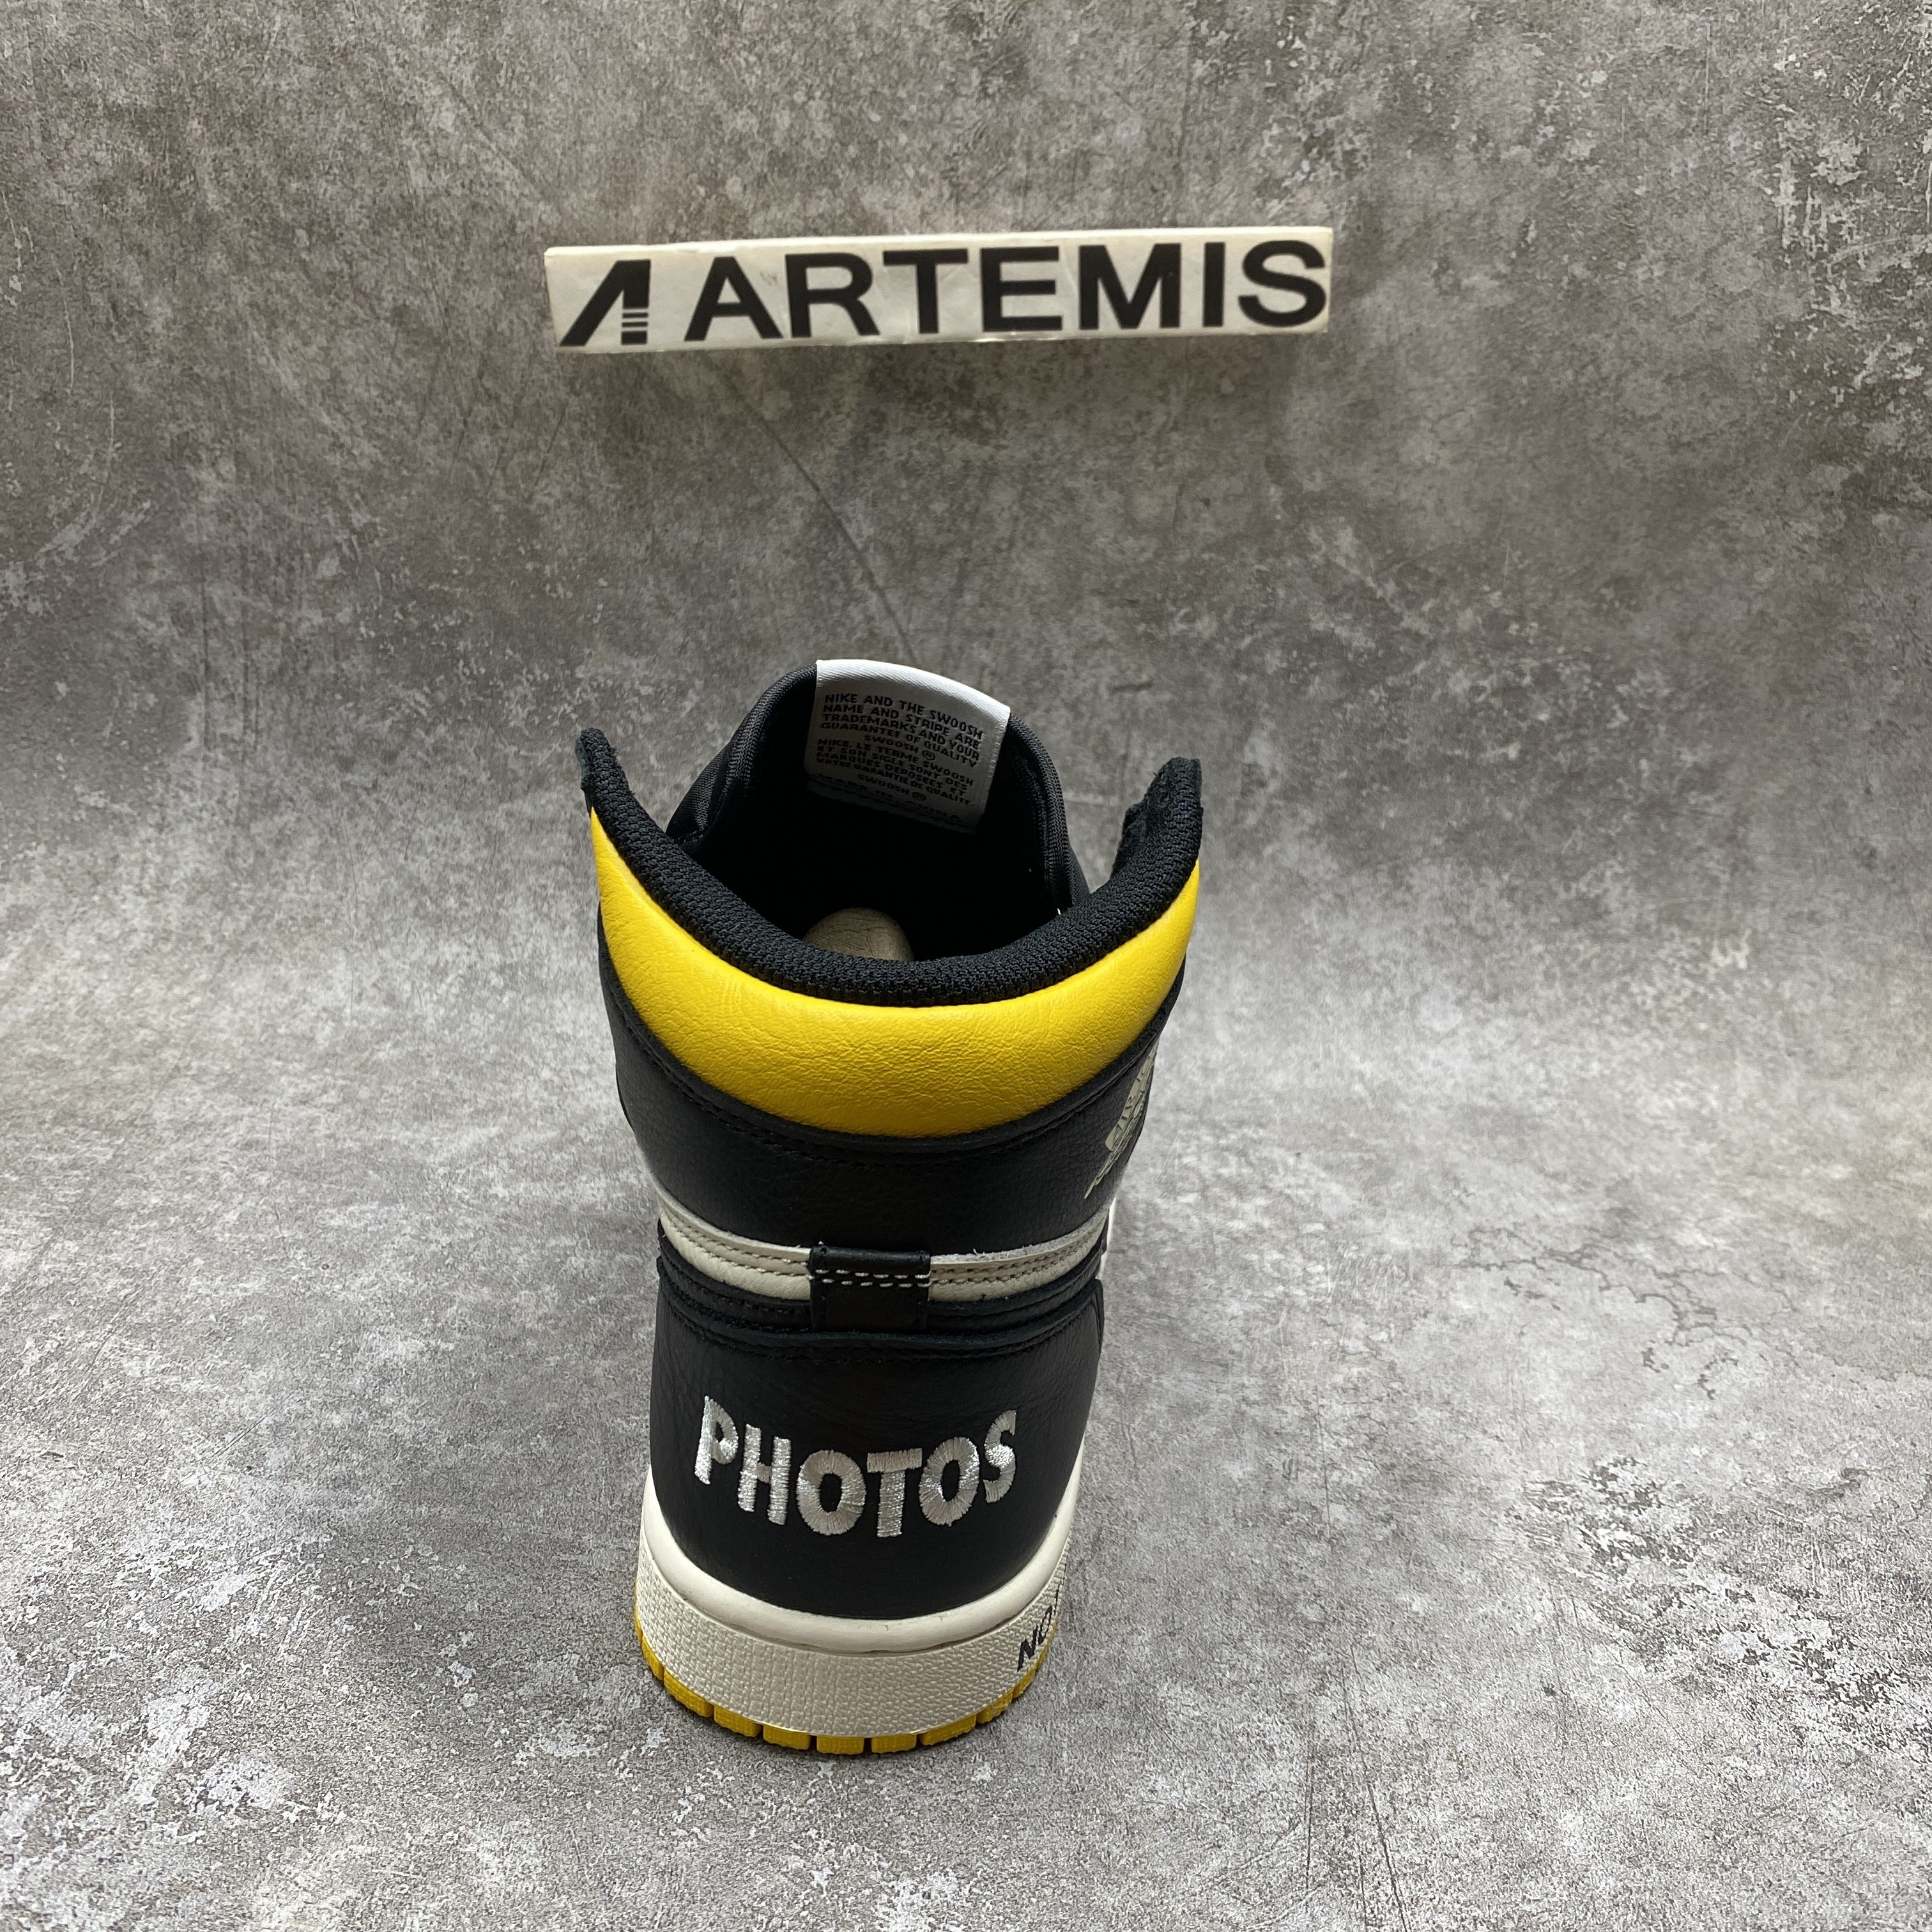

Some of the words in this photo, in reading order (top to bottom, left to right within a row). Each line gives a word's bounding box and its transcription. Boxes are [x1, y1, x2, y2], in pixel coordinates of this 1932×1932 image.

[684, 240, 1328, 342] ARTEMIS
[822, 713, 917, 734] TRADEMARKS
[919, 730, 946, 745] AND
[949, 739, 980, 761] YOUR
[823, 704, 864, 714] NAME
[870, 707, 899, 719] AND
[905, 714, 950, 736] STRIPE
[954, 732, 981, 750] ARE
[824, 693, 858, 703] NIKE
[864, 695, 893, 707] AND
[899, 700, 925, 716] THE
[929, 709, 984, 740] SWOOSH
[820, 722, 901, 739] GUARANTEE
[905, 734, 921, 744] OF
[924, 740, 977, 769] QUALITY
[856, 742, 872, 751] LE
[877, 746, 919, 764] TERME
[923, 760, 974, 786] SWOOSH
[864, 735, 919, 754] SWOOSH
[816, 751, 881, 768] MARQUES
[884, 763, 944, 788] DEPOSEES
[950, 786, 967, 797] ET
[816, 758, 852, 768] VOTRE
[910, 780, 924, 790] DE
[841, 747, 867, 758] SON
[871, 752, 905, 767] SIGLE
[908, 763, 940, 779] SONT
[945, 777, 969, 791] DES
[858, 774, 910, 795] SWOOSH
[694, 1395, 1017, 1538] PHOTOS
